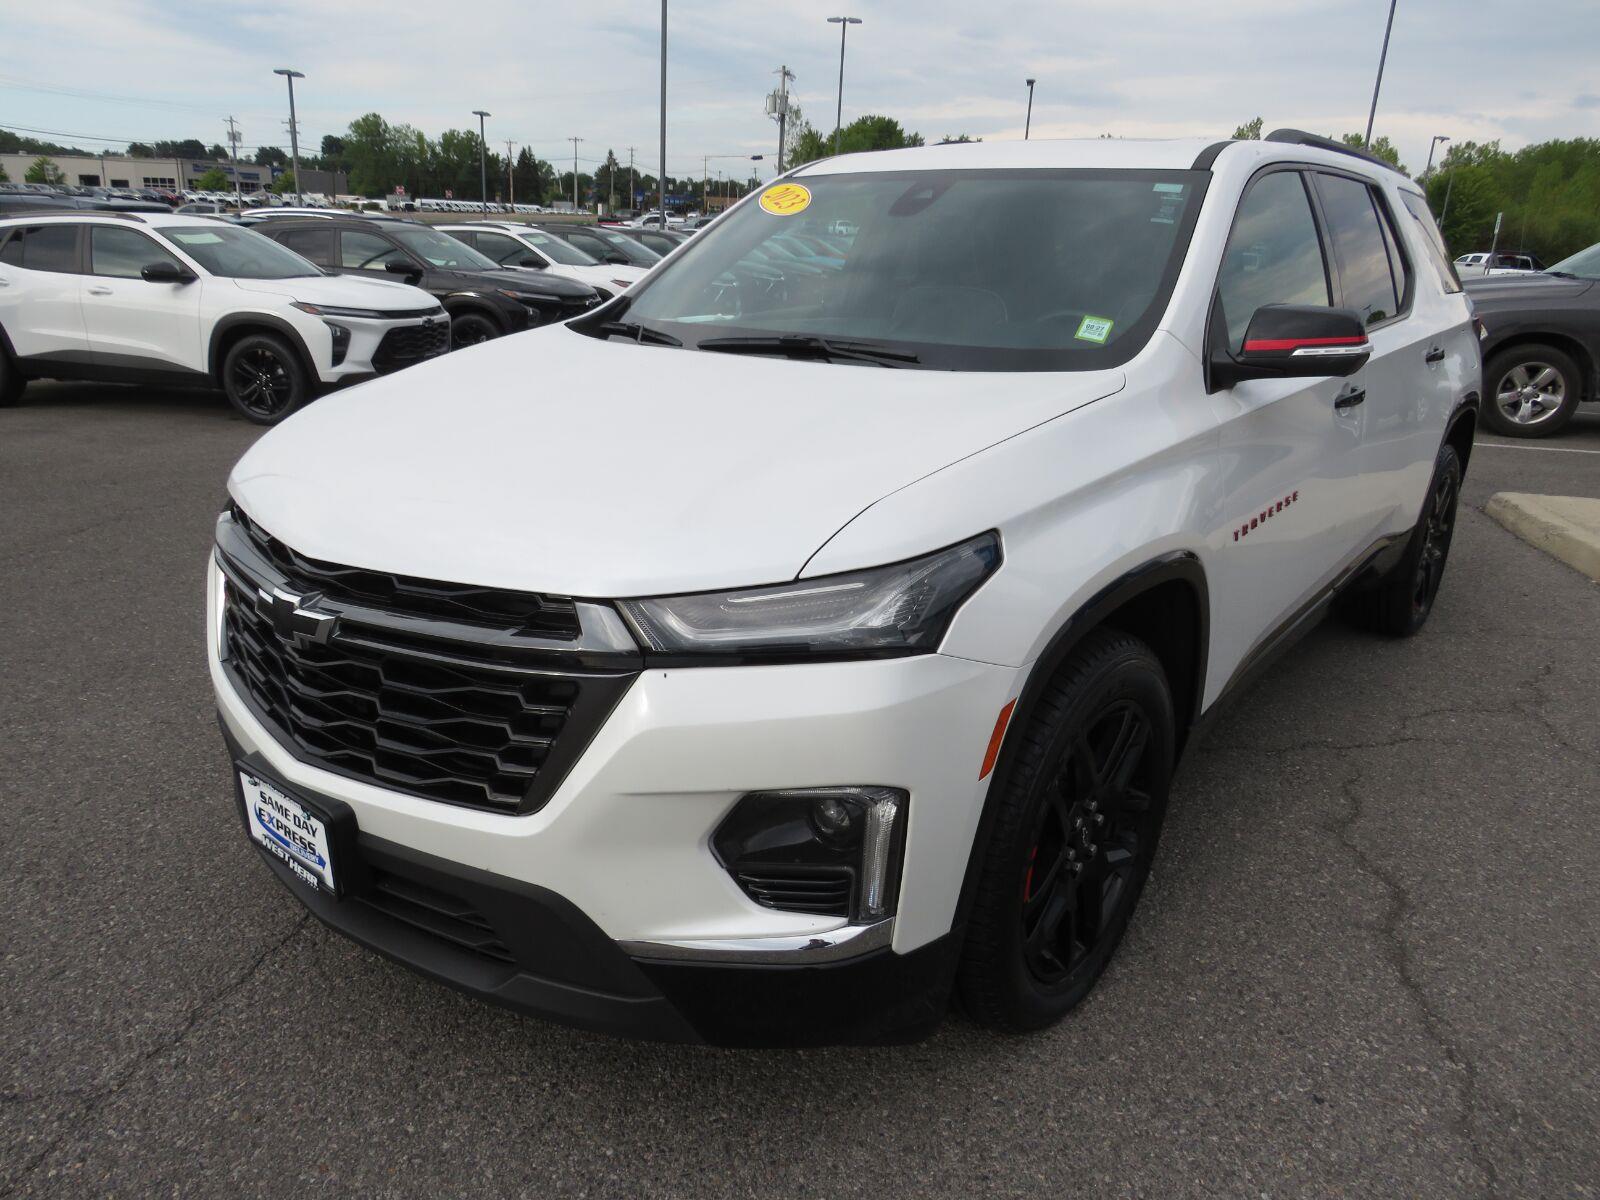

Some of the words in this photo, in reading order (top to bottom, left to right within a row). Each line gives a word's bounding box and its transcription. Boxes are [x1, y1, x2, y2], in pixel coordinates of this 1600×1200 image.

[1234, 490, 1299, 542] TRAVERSE
[258, 807, 317, 856] EXPRESS
[259, 790, 291, 822] SAME
[293, 813, 318, 838] DAY
[262, 834, 291, 862] WEST
